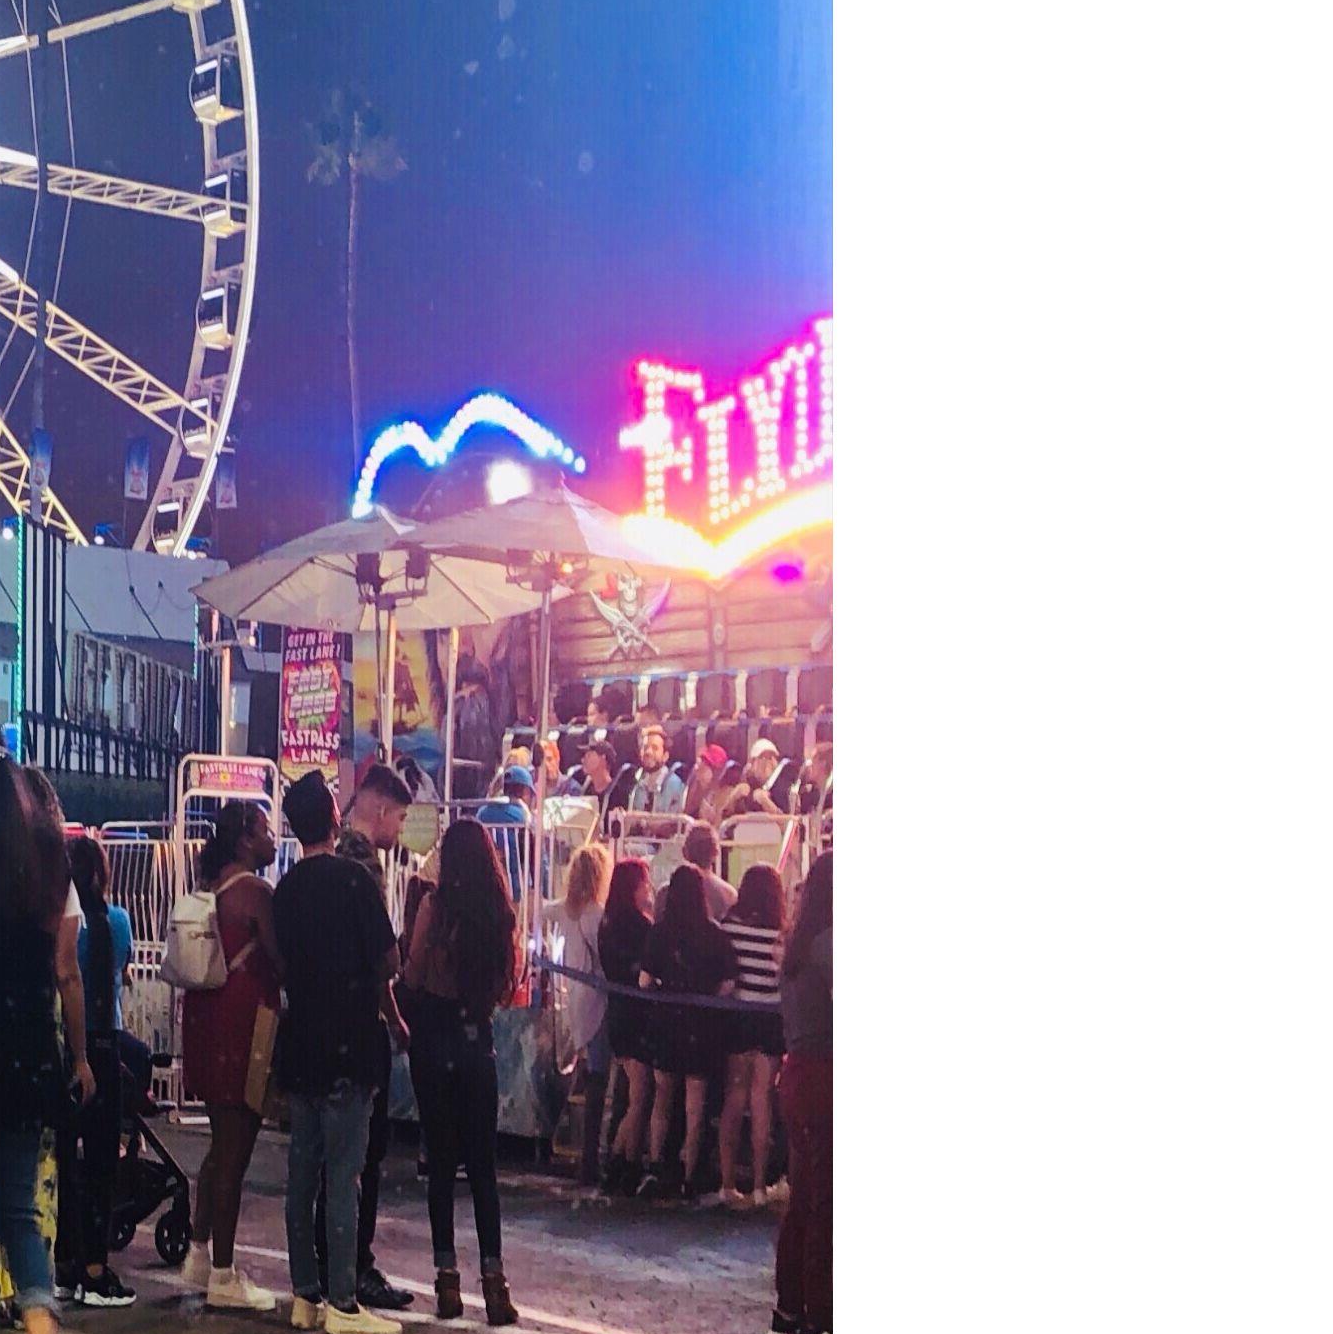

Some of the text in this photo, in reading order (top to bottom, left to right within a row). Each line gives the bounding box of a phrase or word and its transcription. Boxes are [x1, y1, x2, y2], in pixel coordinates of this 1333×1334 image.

[288, 634, 304, 648] GET
[305, 633, 316, 647] IN
[285, 648, 307, 663] FAST
[282, 730, 340, 750] FASTPASS
[290, 748, 331, 764] LANE
